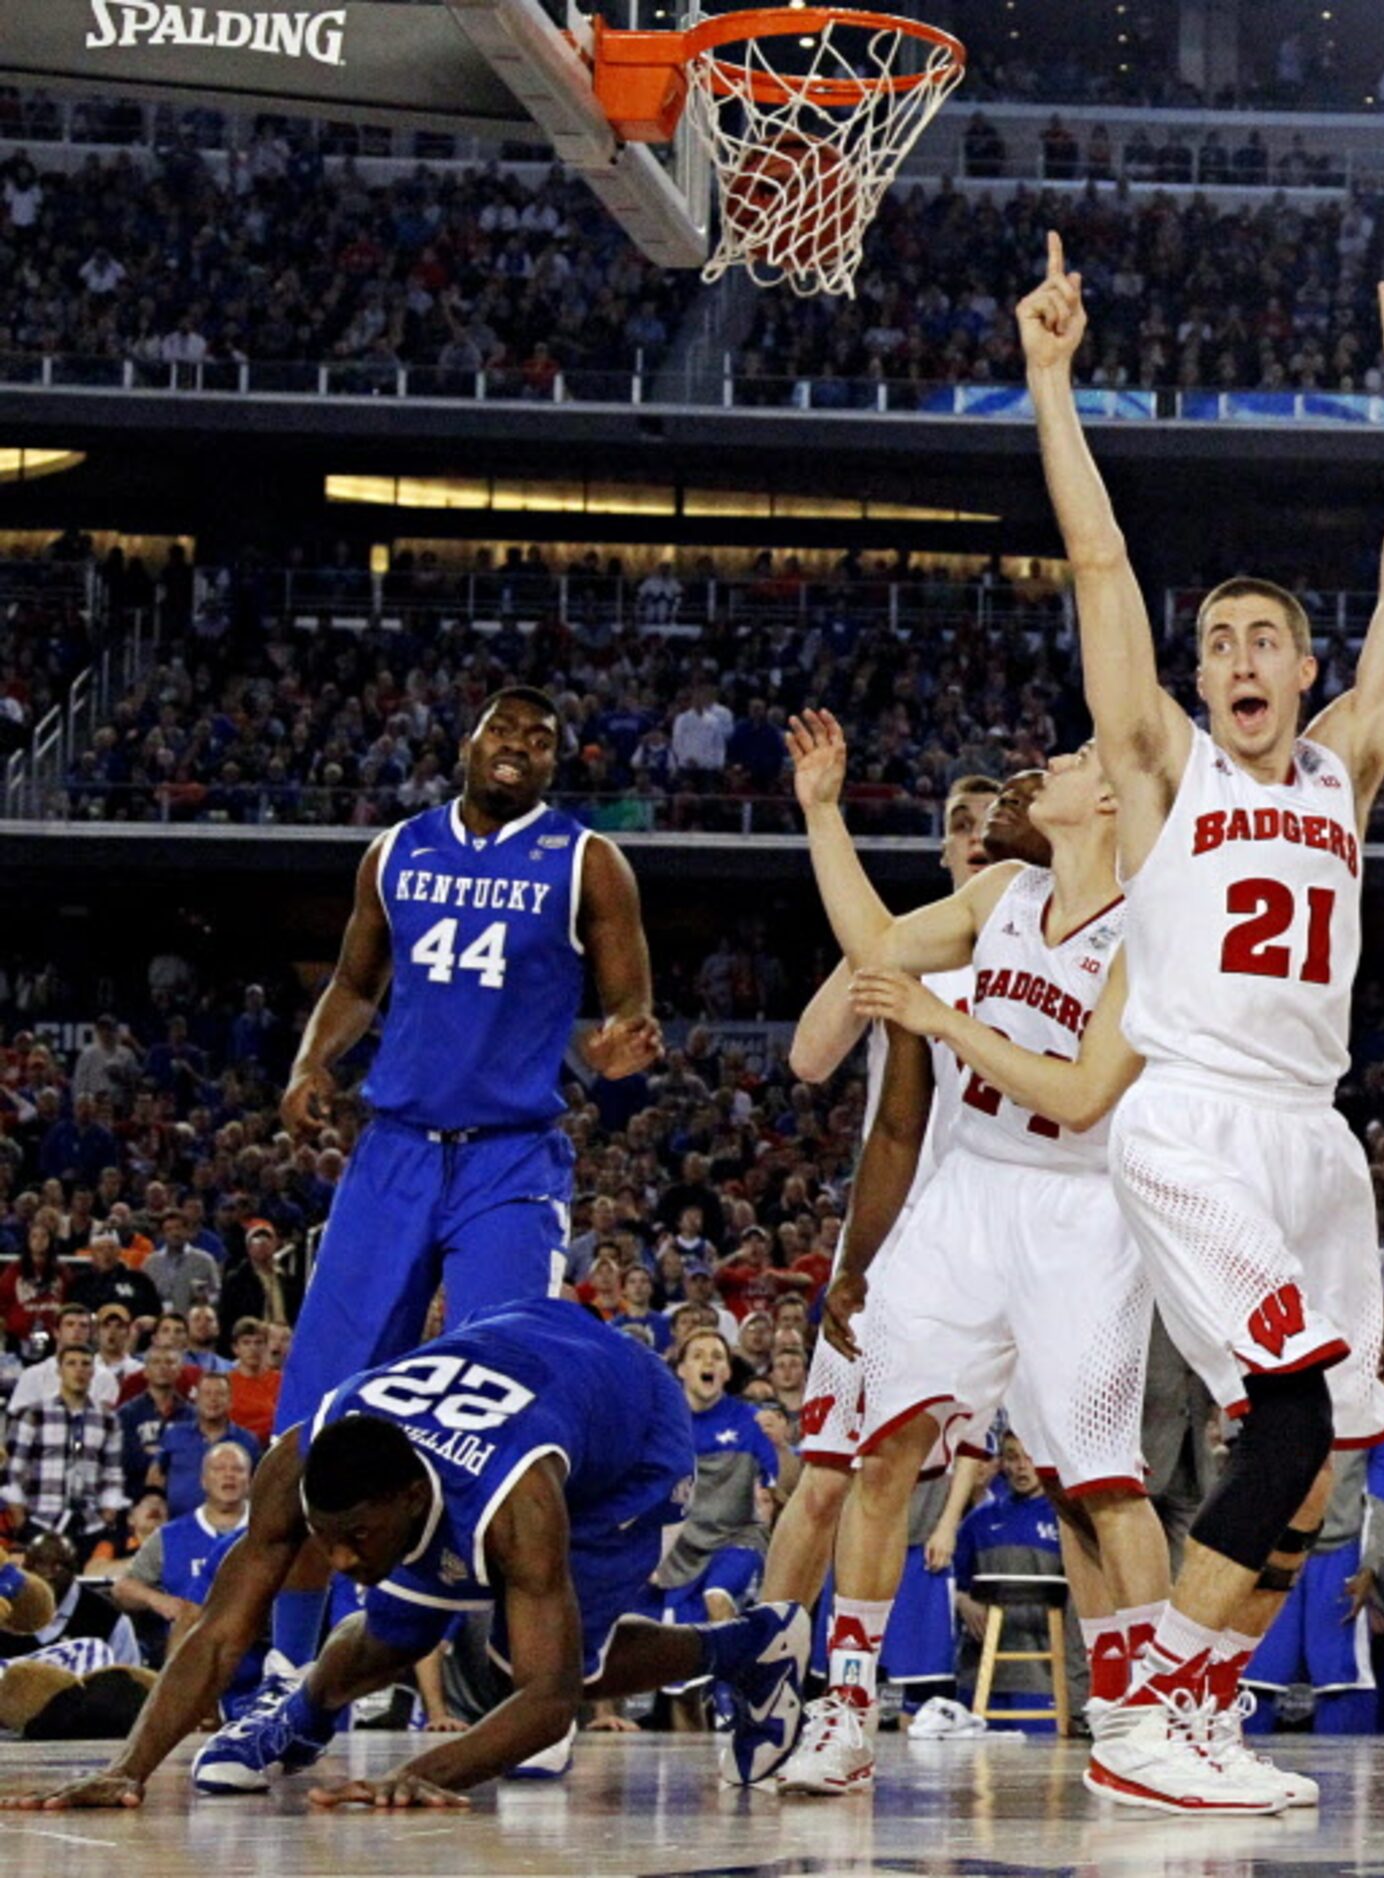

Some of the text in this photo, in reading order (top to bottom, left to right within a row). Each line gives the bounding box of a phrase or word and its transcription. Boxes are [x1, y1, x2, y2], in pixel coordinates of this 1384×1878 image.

[86, 0, 346, 66] SPALDING
[1192, 807, 1358, 879] BADGERS
[395, 869, 551, 914] KENTUCKY
[411, 917, 507, 988] 44
[1219, 876, 1335, 985] 21
[357, 1355, 537, 1431] 22
